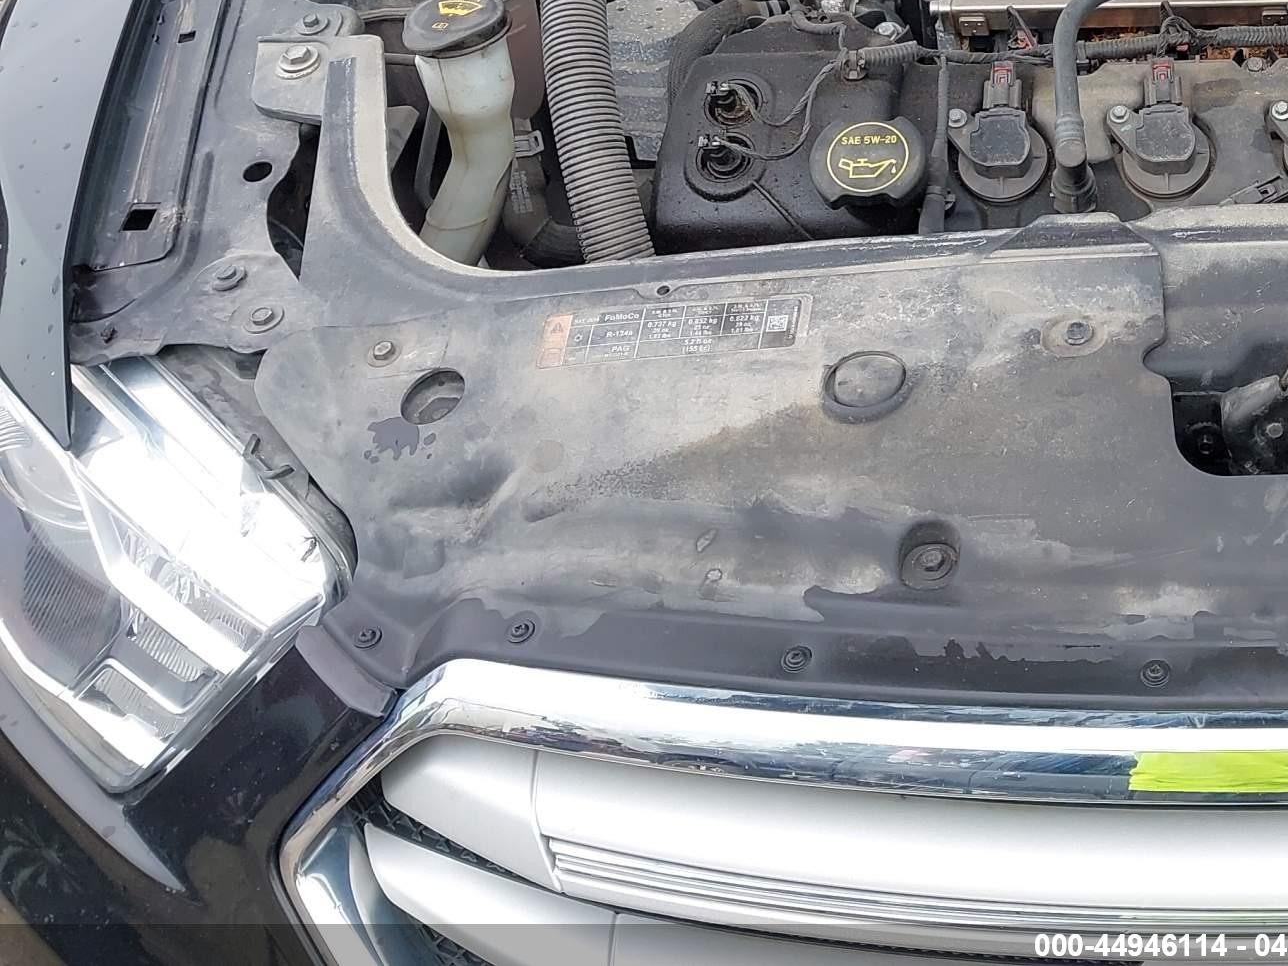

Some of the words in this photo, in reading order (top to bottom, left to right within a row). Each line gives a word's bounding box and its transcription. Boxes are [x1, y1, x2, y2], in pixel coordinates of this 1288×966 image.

[841, 136, 861, 145] SAE
[863, 135, 897, 144] 5W-20
[604, 312, 640, 322] FoMoCo
[611, 345, 631, 353] PAG
